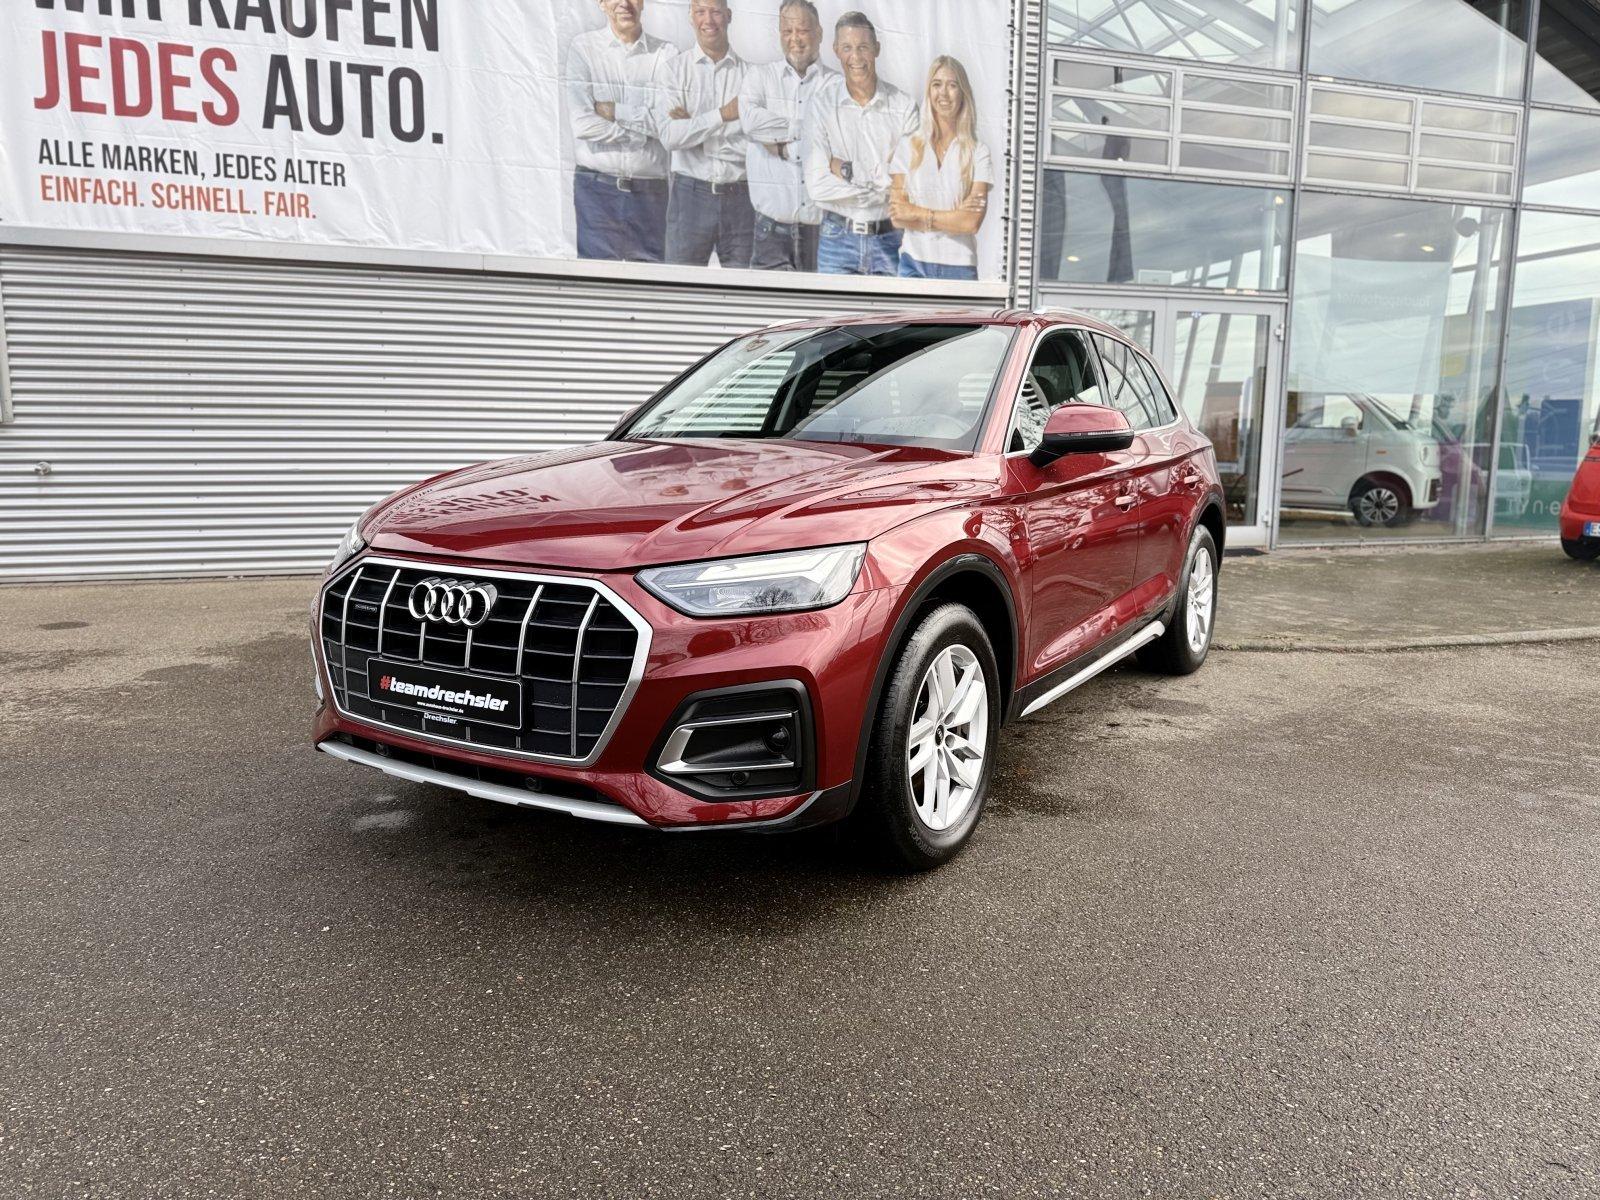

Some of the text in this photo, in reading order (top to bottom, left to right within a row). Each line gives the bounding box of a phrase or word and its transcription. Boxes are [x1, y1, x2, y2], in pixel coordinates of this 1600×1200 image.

[33, 30, 444, 145] JEDES AUTO.
[38, 138, 347, 188] ALLE MARKEN, JEDES ALTER
[40, 175, 317, 220] EINFACH. SCHNELL. FAIR.
[380, 675, 509, 712] #teamdrechsler
